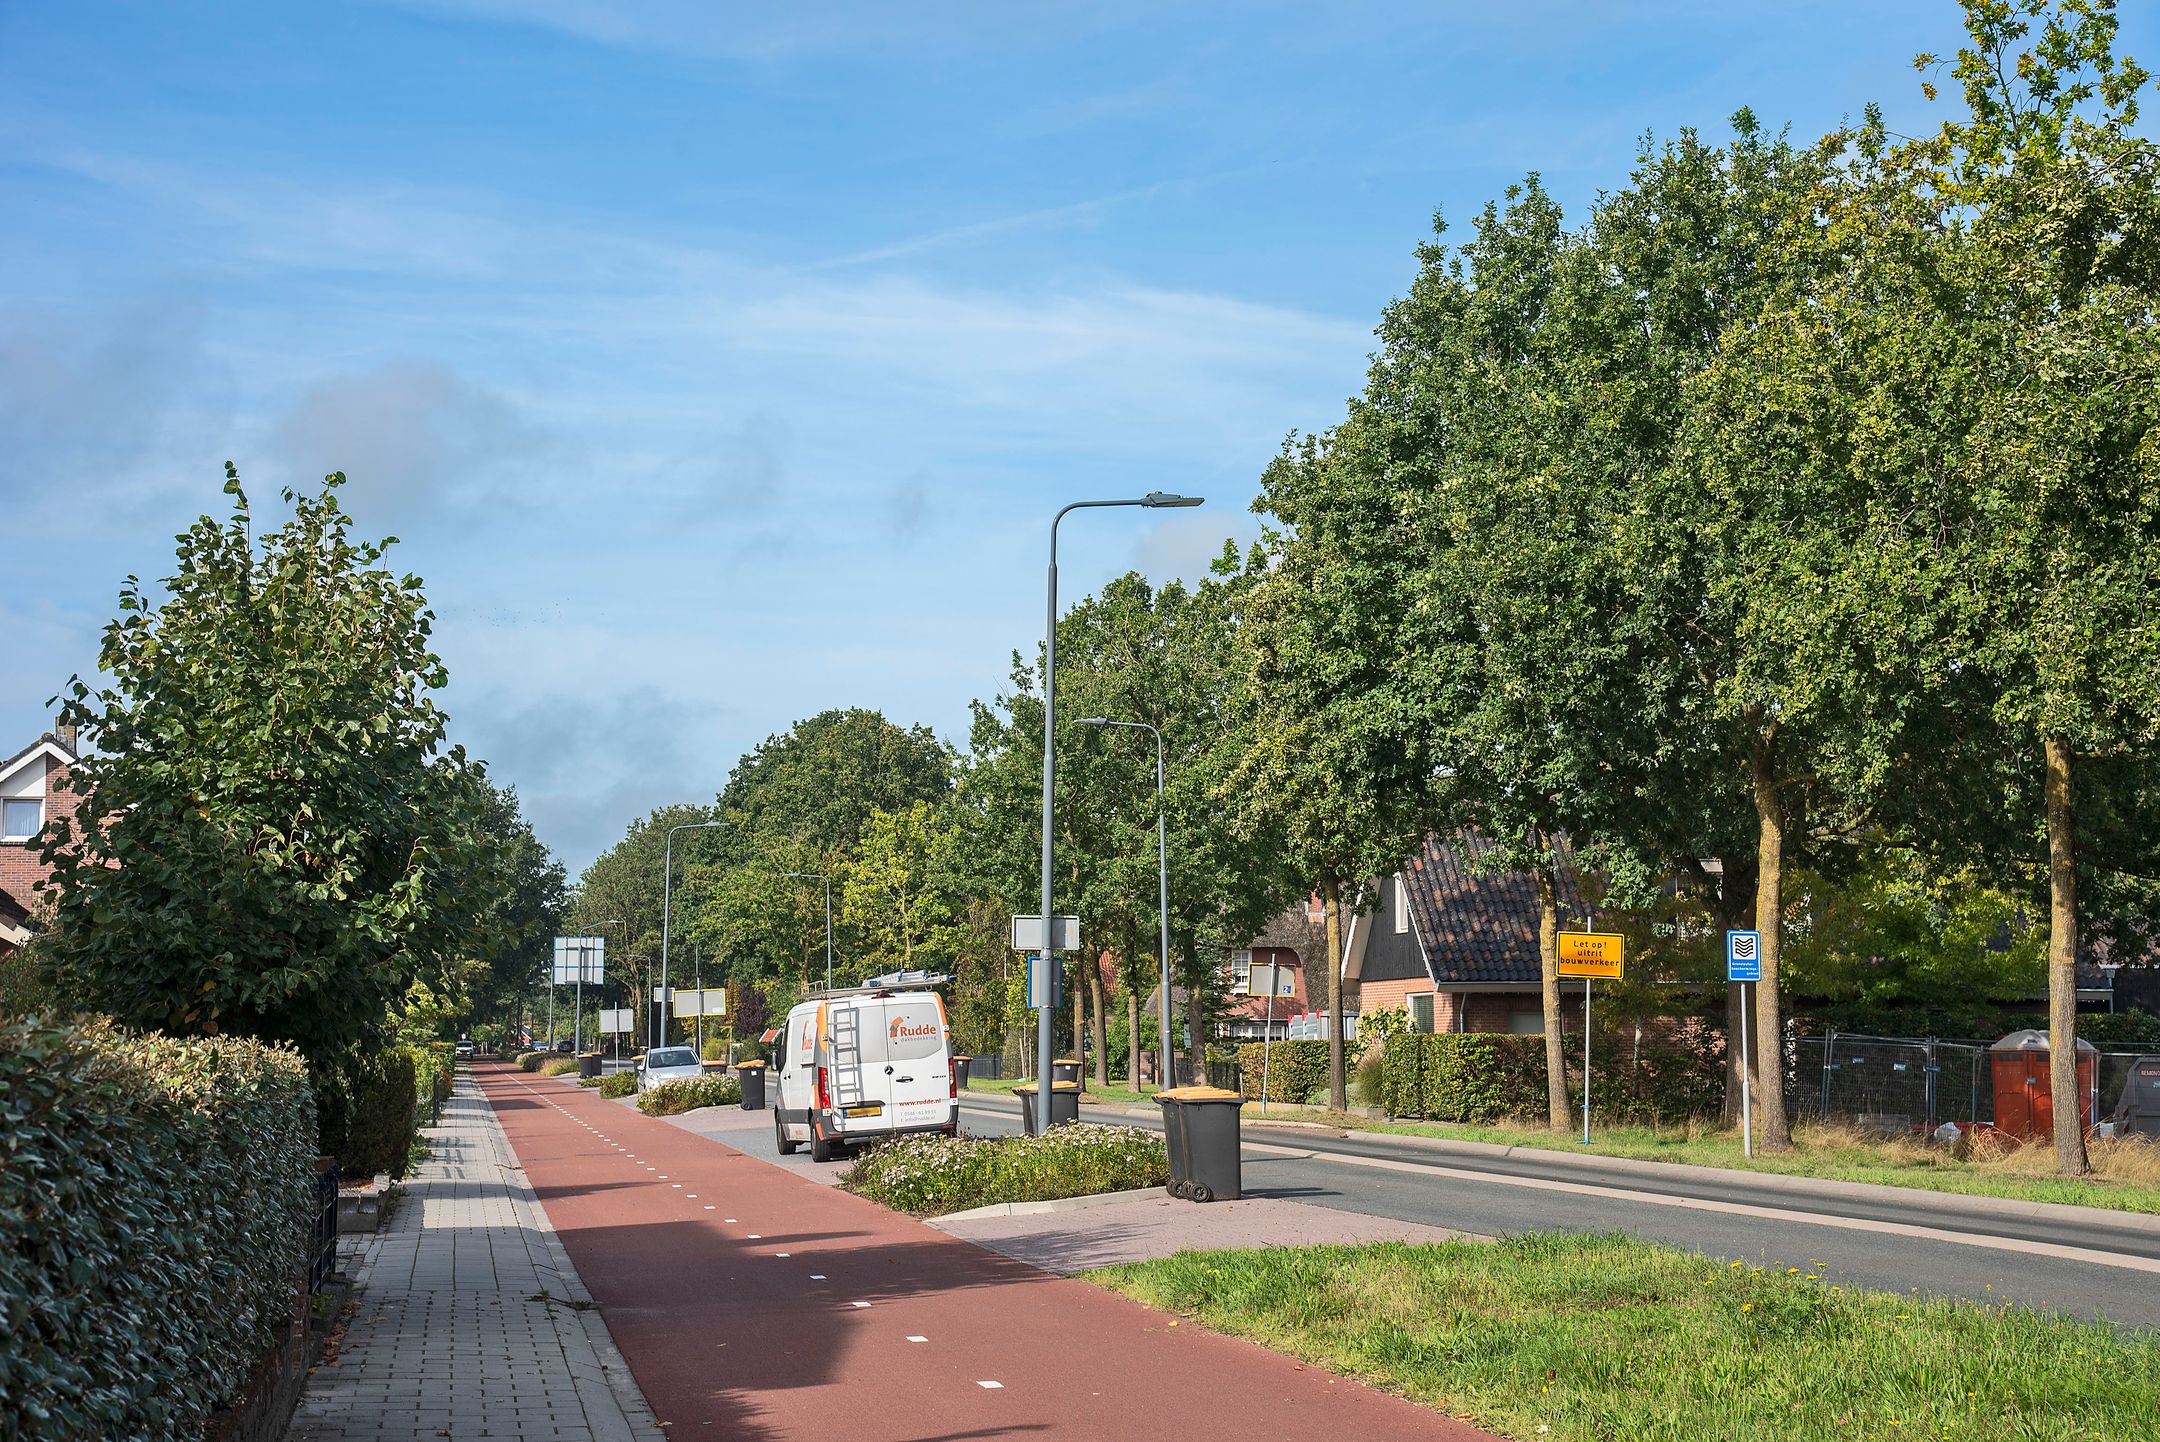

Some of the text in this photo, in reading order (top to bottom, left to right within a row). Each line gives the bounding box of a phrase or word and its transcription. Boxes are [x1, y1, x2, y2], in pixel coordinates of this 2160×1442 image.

[1573, 940, 1588, 948] Let
[1577, 949, 1603, 957] uitrit
[1560, 956, 1620, 967] bouwverkeer
[900, 1024, 937, 1037] Rudde
[899, 1098, 941, 1107] www.rudde.nl
